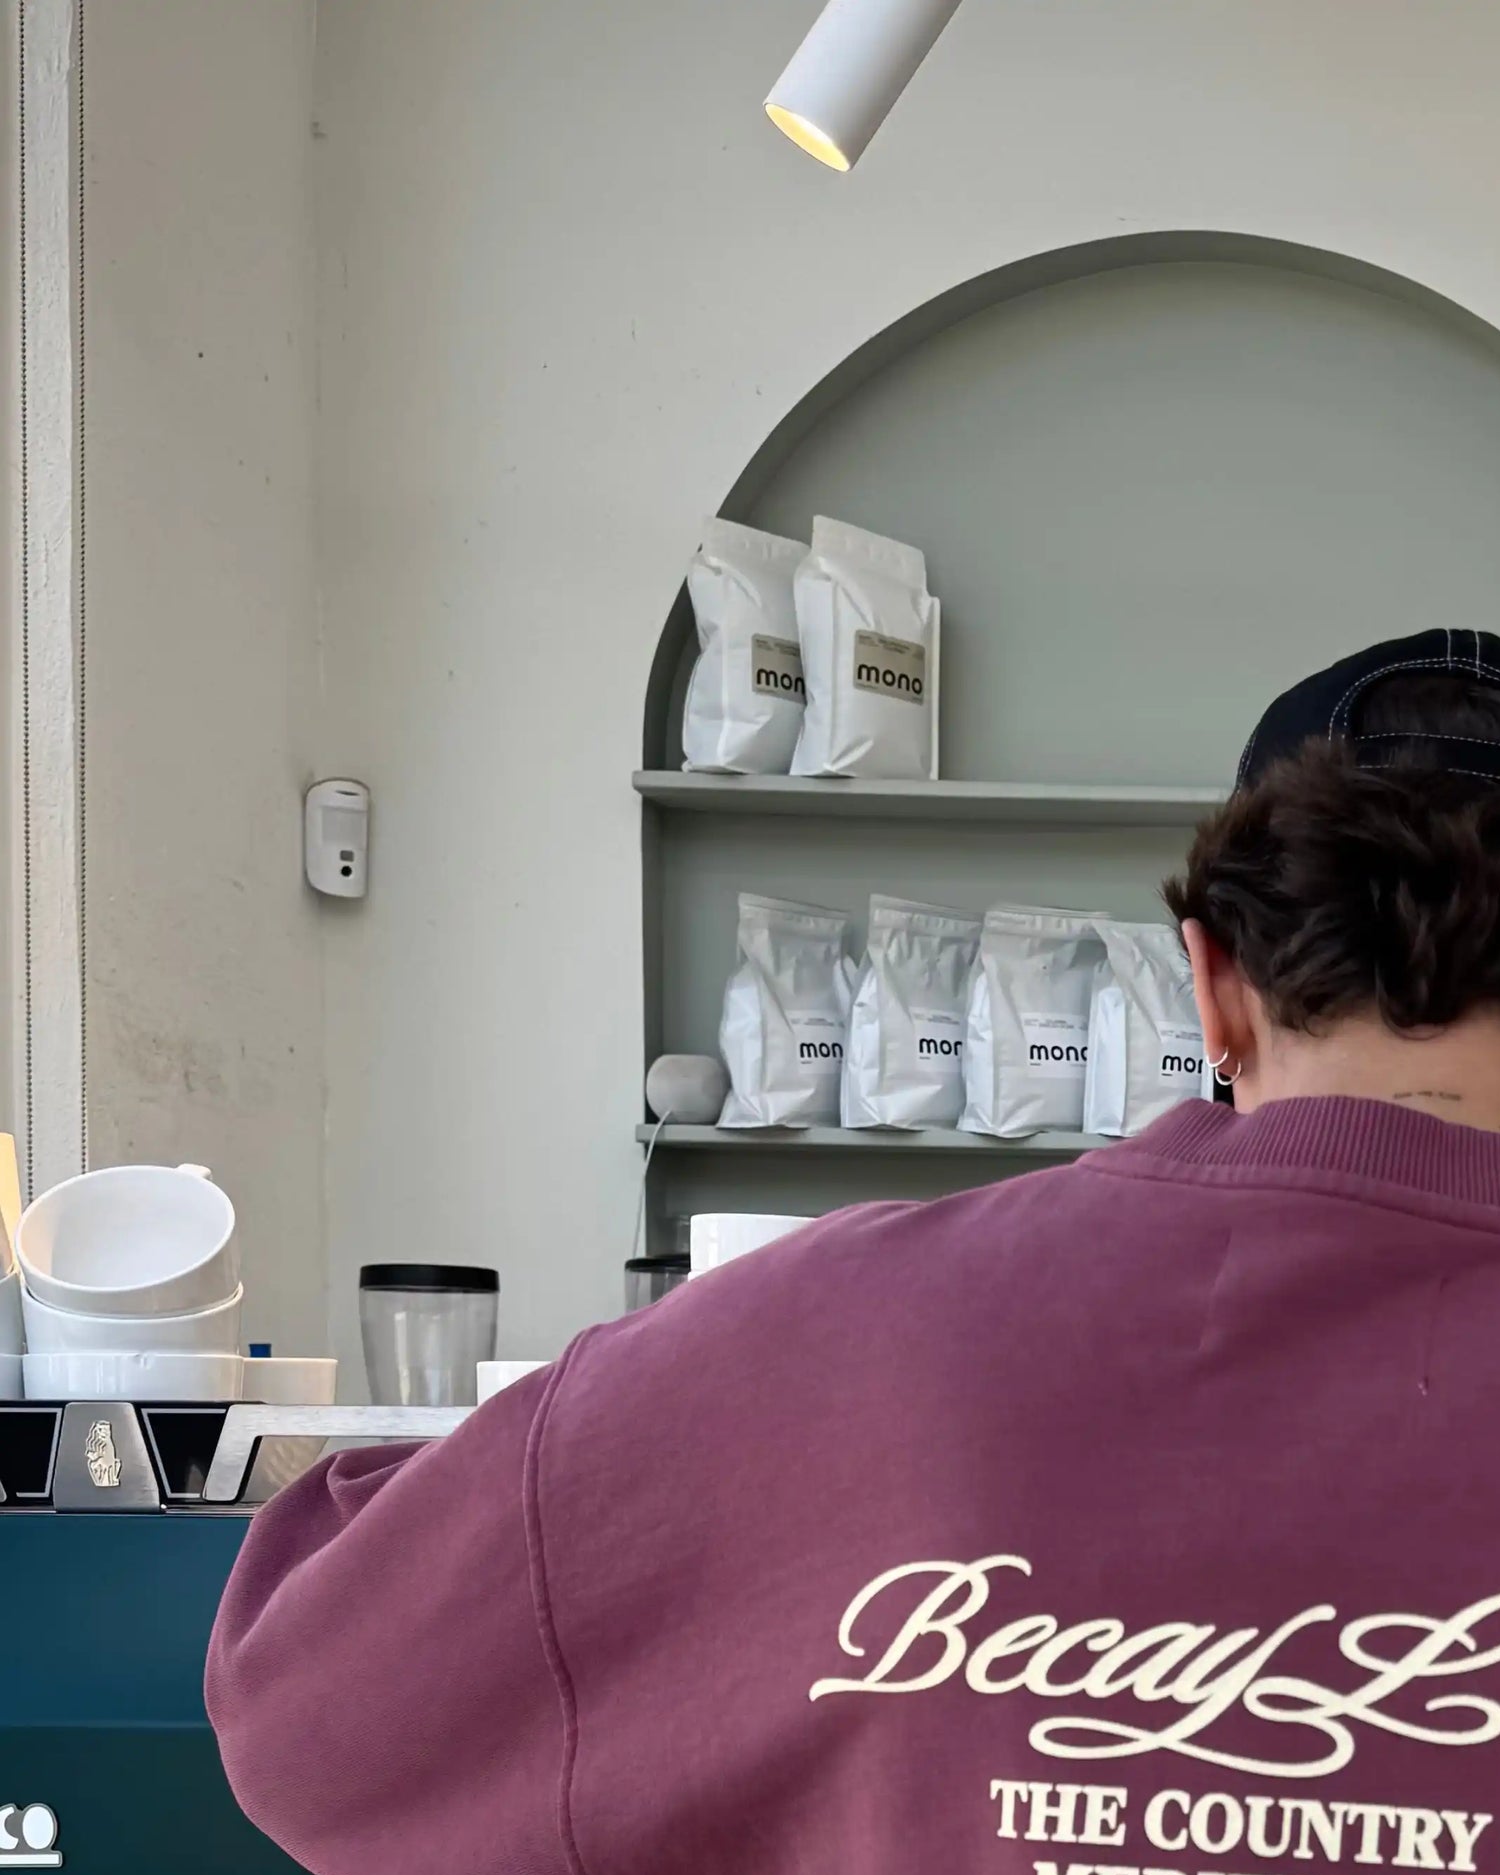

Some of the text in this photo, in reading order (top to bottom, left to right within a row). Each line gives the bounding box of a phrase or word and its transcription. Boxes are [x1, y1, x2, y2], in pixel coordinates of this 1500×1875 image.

[857, 664, 923, 694] mono
[809, 1555, 1355, 1779] Becay
[989, 1778, 1128, 1847] THE
[1144, 1789, 1493, 1872] COUNTRY
